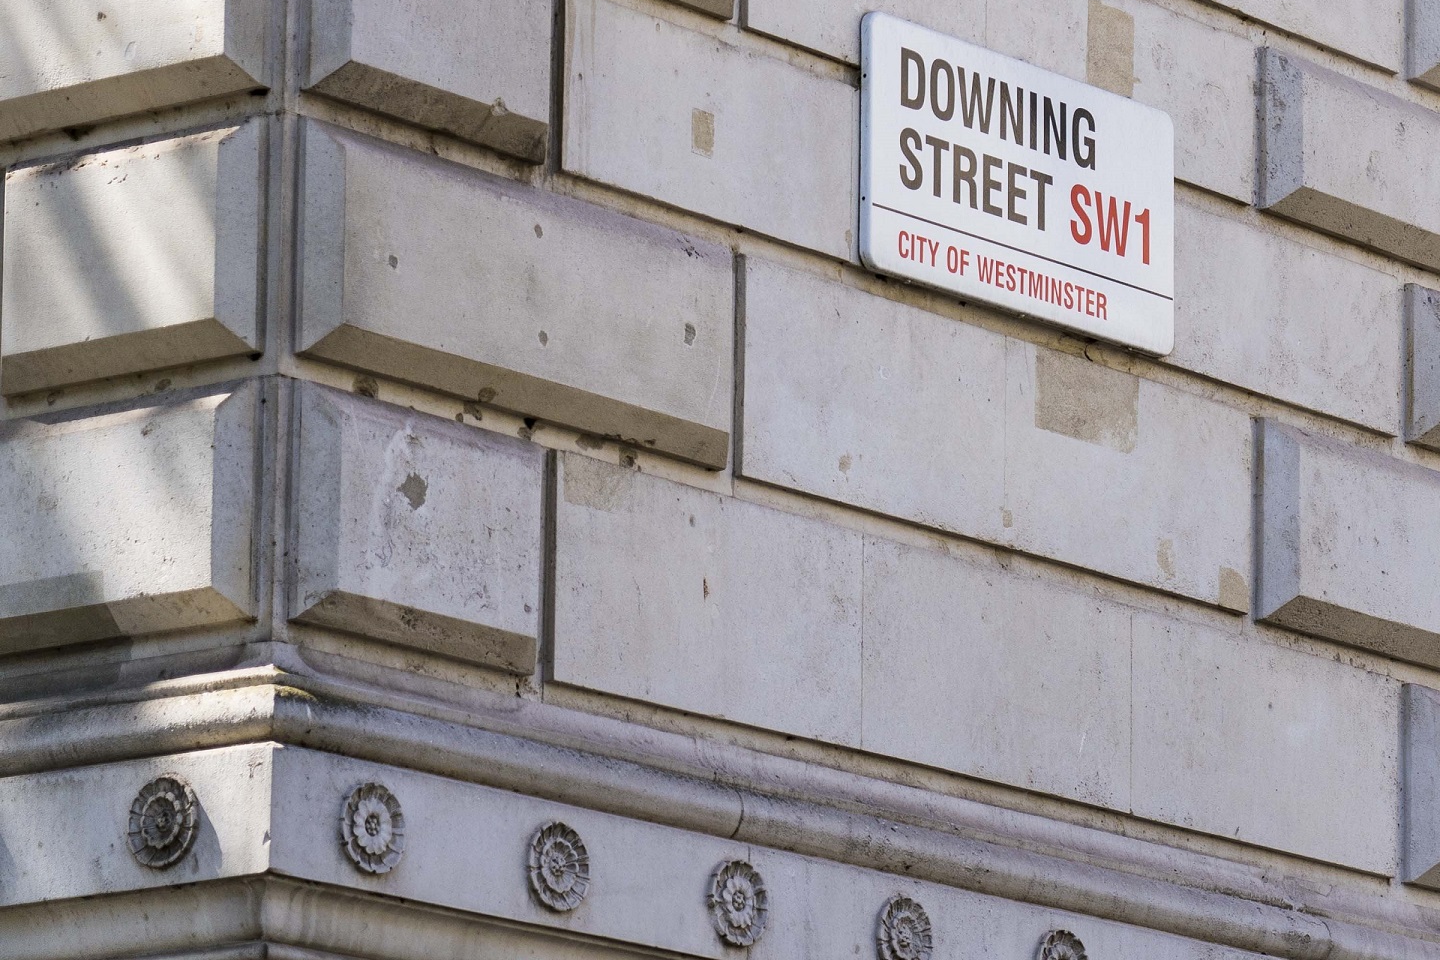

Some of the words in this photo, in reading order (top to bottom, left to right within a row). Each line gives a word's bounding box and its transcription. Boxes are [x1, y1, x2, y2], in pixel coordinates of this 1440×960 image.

[900, 46, 1096, 171] DOWNING
[899, 127, 1054, 232] STREET
[1070, 183, 1150, 265] SW1
[898, 230, 940, 267] CITY
[946, 245, 970, 277] OF
[977, 254, 1108, 320] WESTMINSTER
